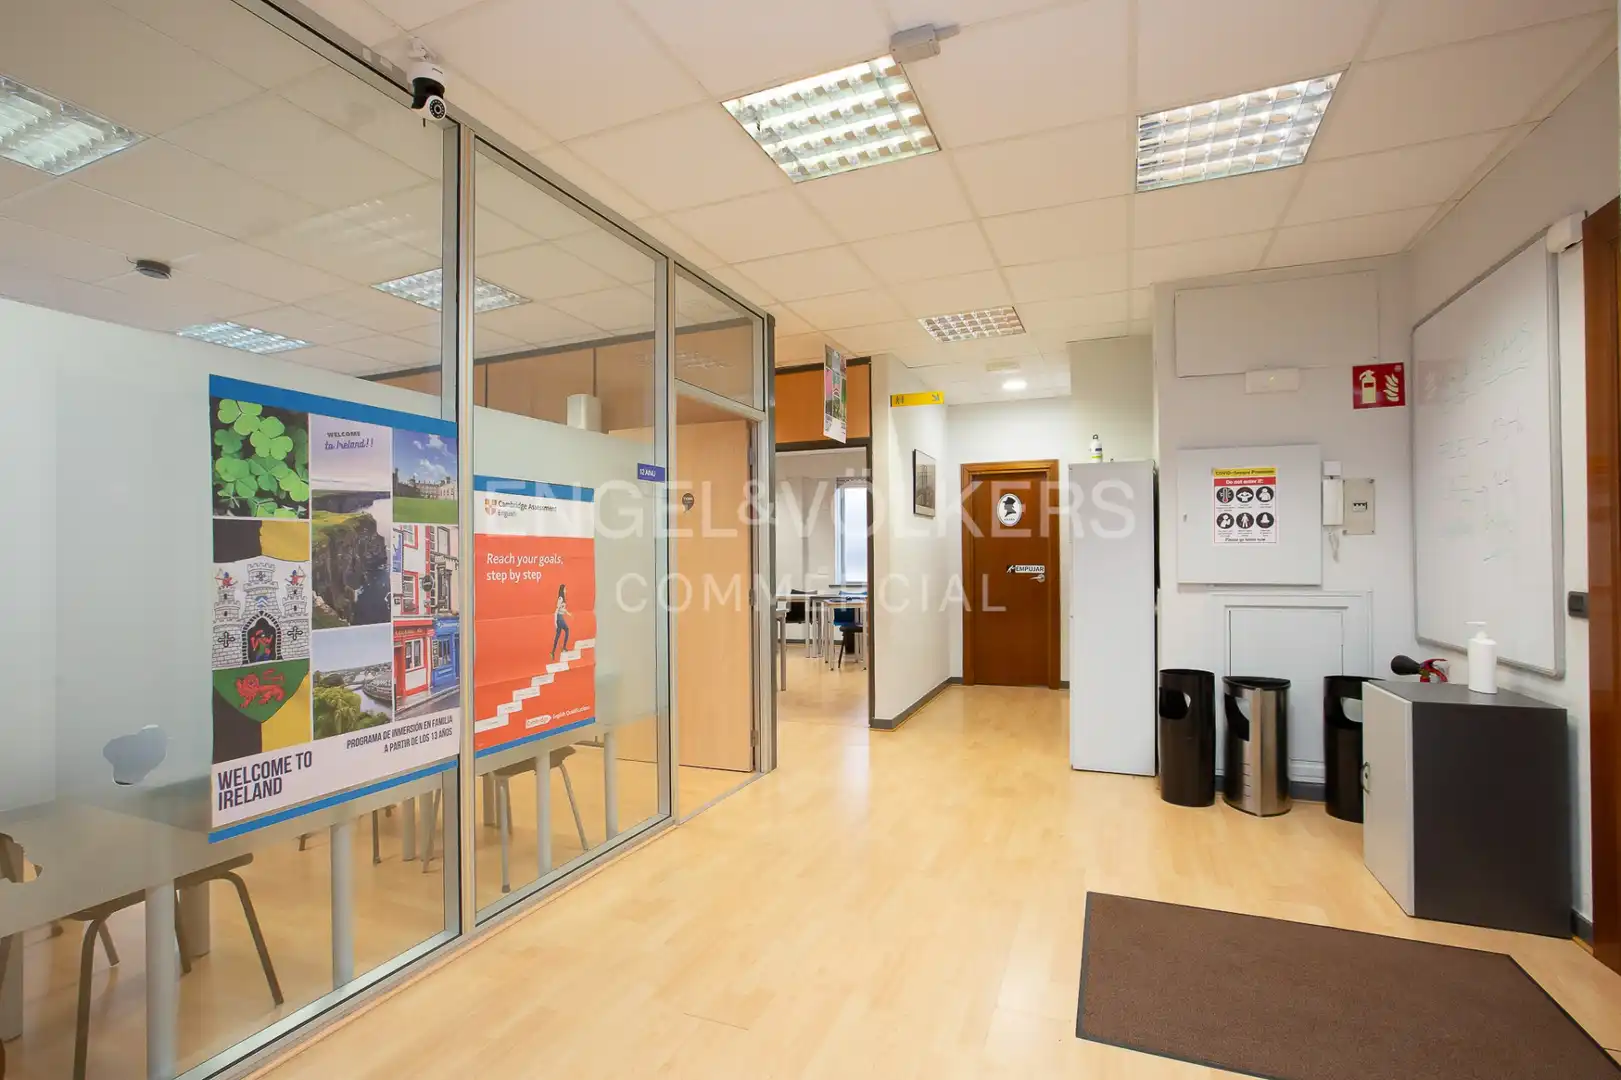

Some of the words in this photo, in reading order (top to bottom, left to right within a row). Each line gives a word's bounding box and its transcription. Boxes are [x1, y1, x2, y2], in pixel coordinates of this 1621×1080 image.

[325, 441, 335, 450] to
[498, 500, 527, 511] Cambridge
[487, 552, 515, 564] Reach
[516, 555, 537, 567] your
[486, 570, 507, 583] step
[509, 568, 521, 583] by
[523, 570, 542, 584] step
[347, 733, 382, 749] PROGRAMA
[383, 731, 390, 740] DE
[391, 722, 423, 737] INMERSIÓN
[424, 720, 431, 729] EN
[432, 715, 453, 728] FAMILIA
[384, 744, 389, 753] A
[390, 739, 410, 752] PARTIR
[411, 736, 418, 745] DE
[419, 733, 429, 743] LOS
[431, 731, 437, 740] 13
[439, 727, 453, 738] AÑOS
[217, 755, 292, 790] WELCOME
[295, 751, 312, 770] TO
[218, 777, 282, 811] IRELAND
